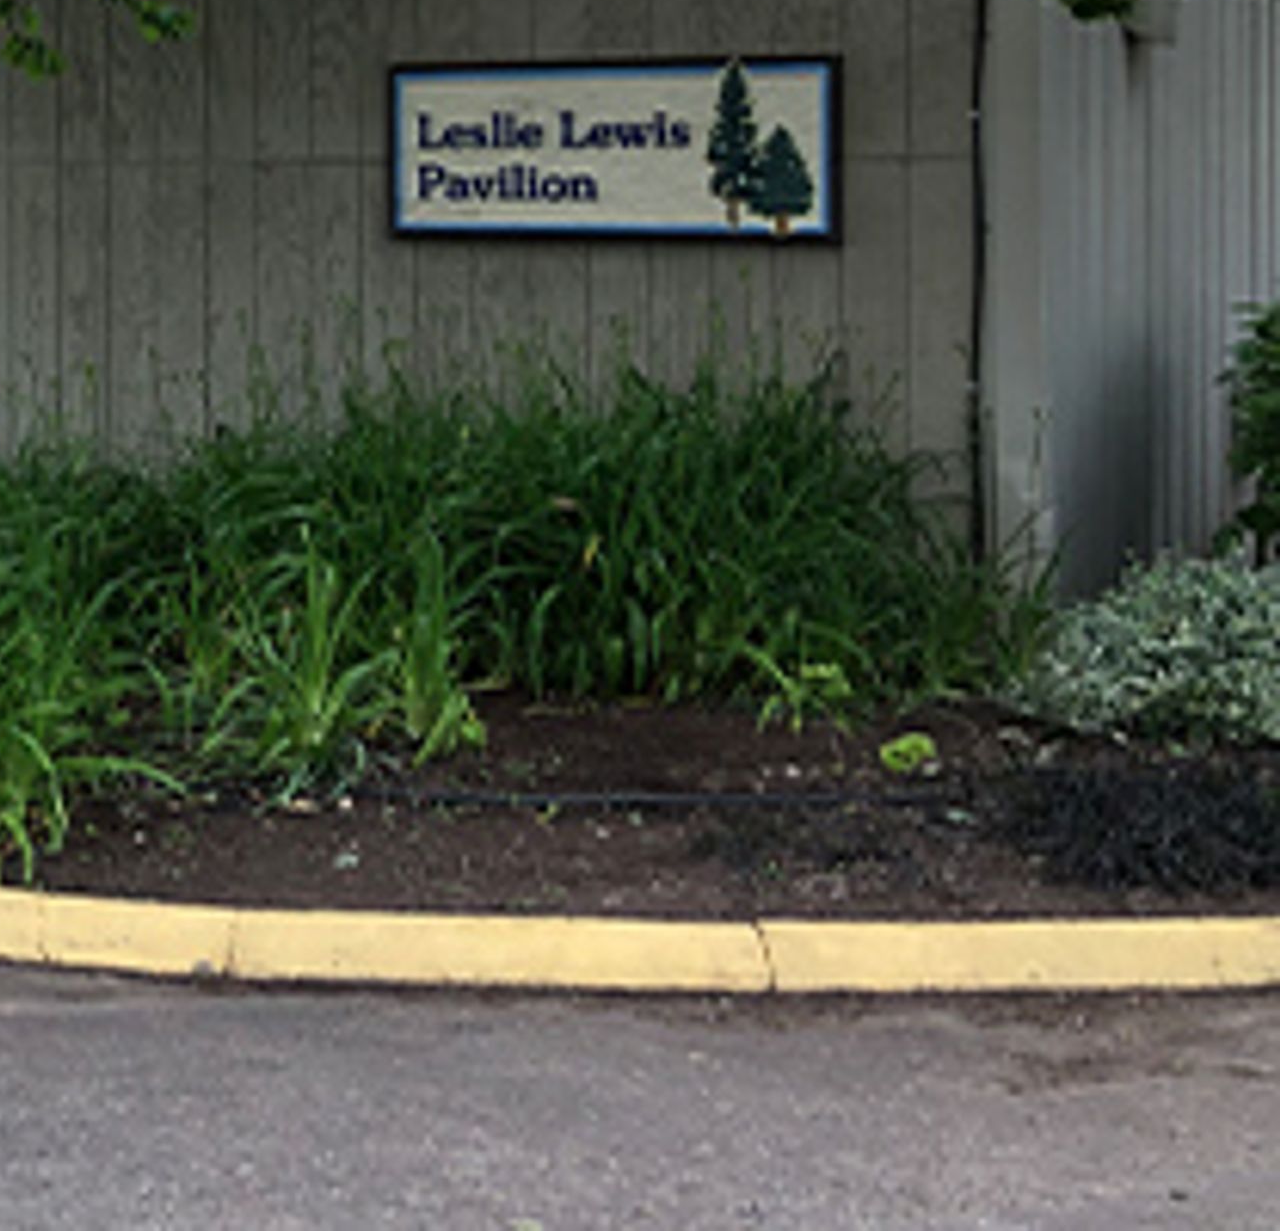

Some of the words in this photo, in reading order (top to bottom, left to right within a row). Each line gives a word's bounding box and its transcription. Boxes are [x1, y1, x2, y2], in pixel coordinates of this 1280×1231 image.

[418, 110, 543, 149] Leslie
[559, 109, 690, 149] Lewis
[417, 163, 598, 203] Pavilion
